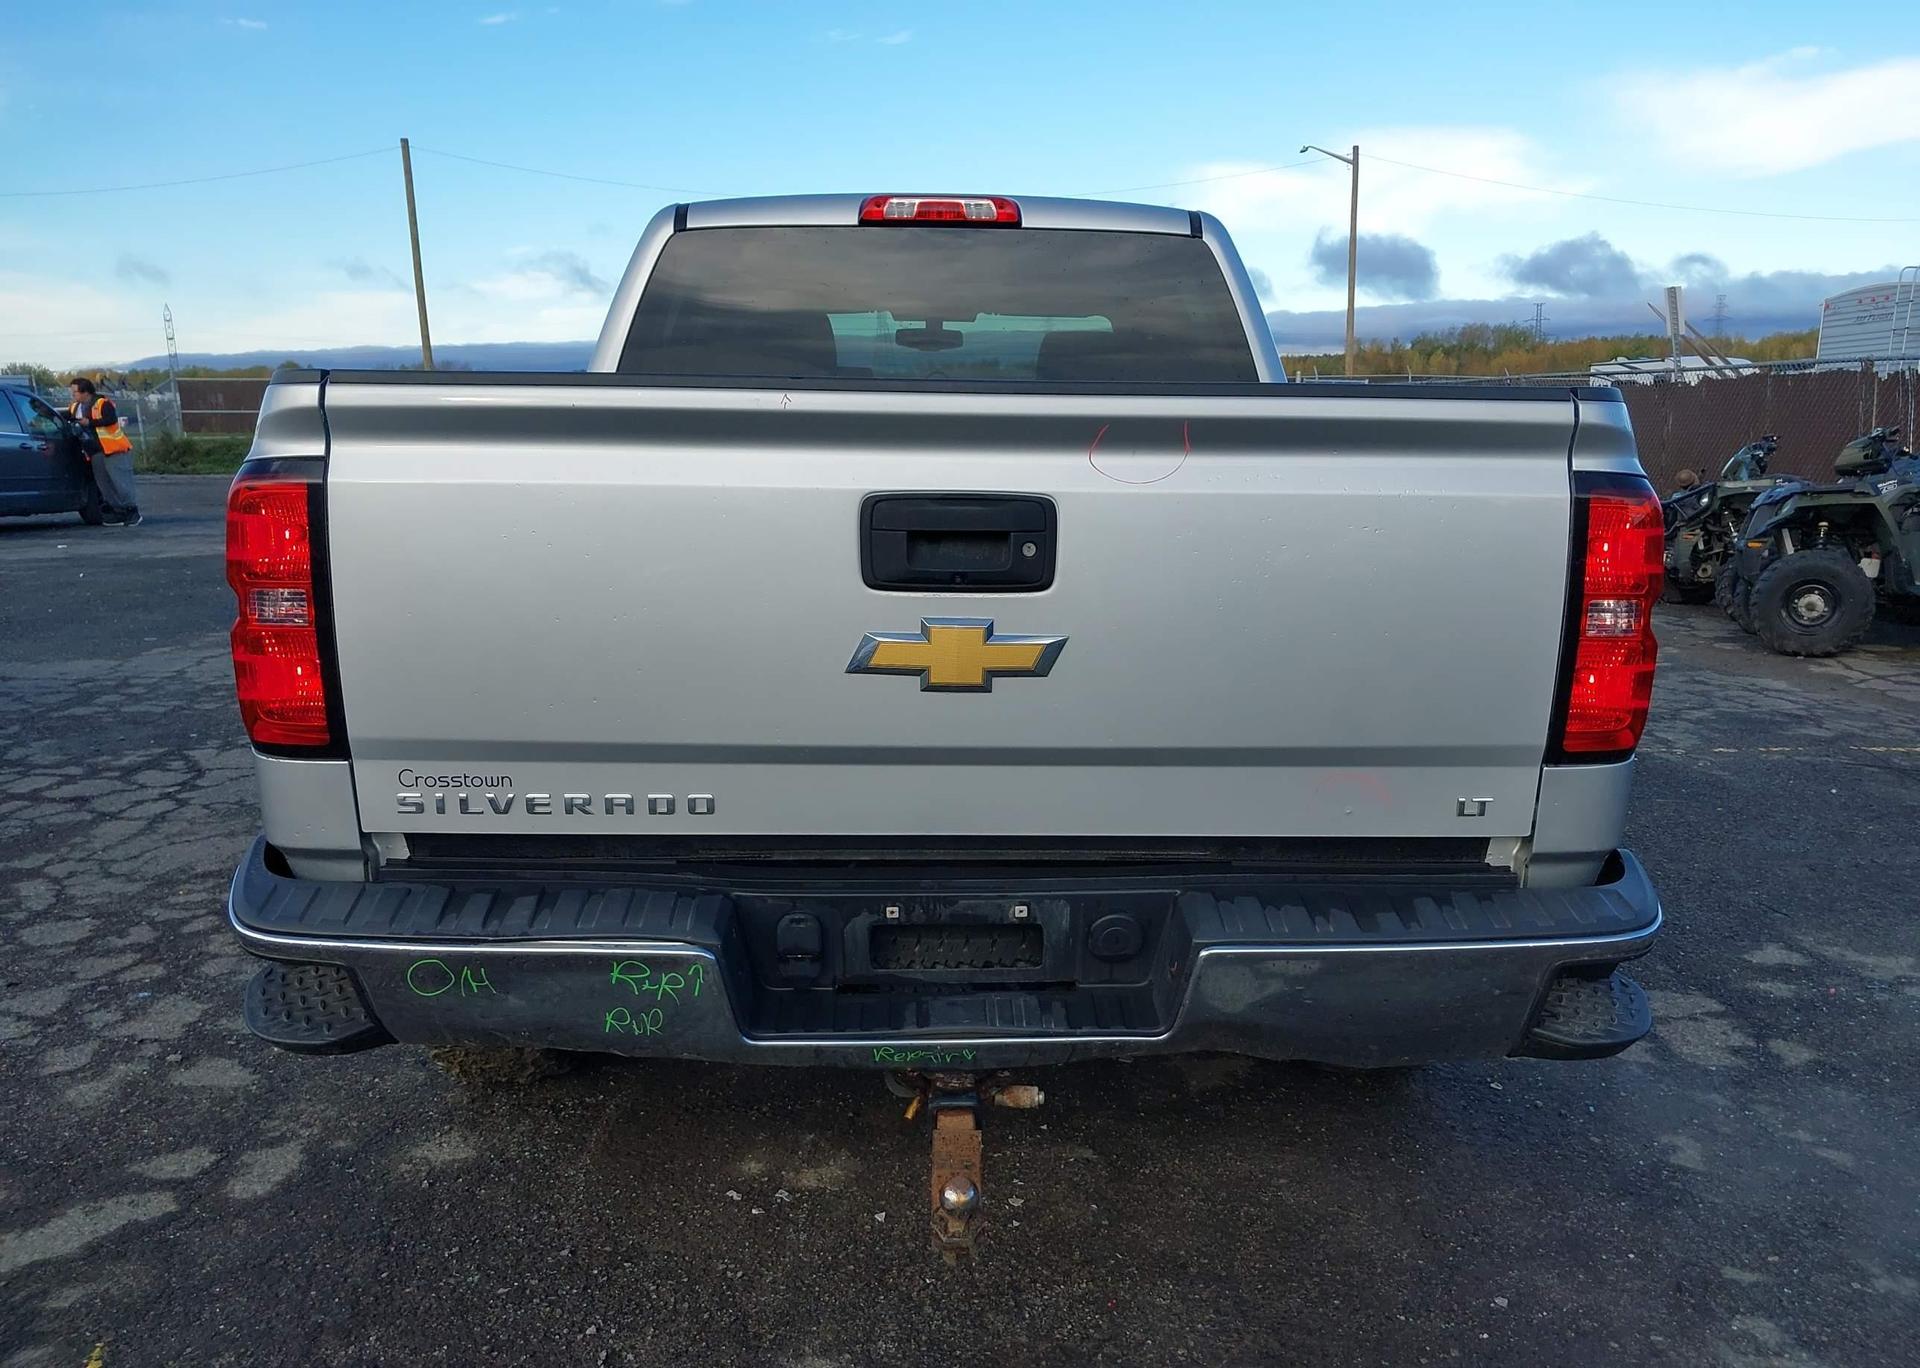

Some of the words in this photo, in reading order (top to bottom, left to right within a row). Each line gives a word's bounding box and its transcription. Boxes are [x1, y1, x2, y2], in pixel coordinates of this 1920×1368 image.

[398, 768, 514, 788] Crosstown
[396, 792, 717, 815] SILVERADO
[1456, 797, 1494, 817] LT
